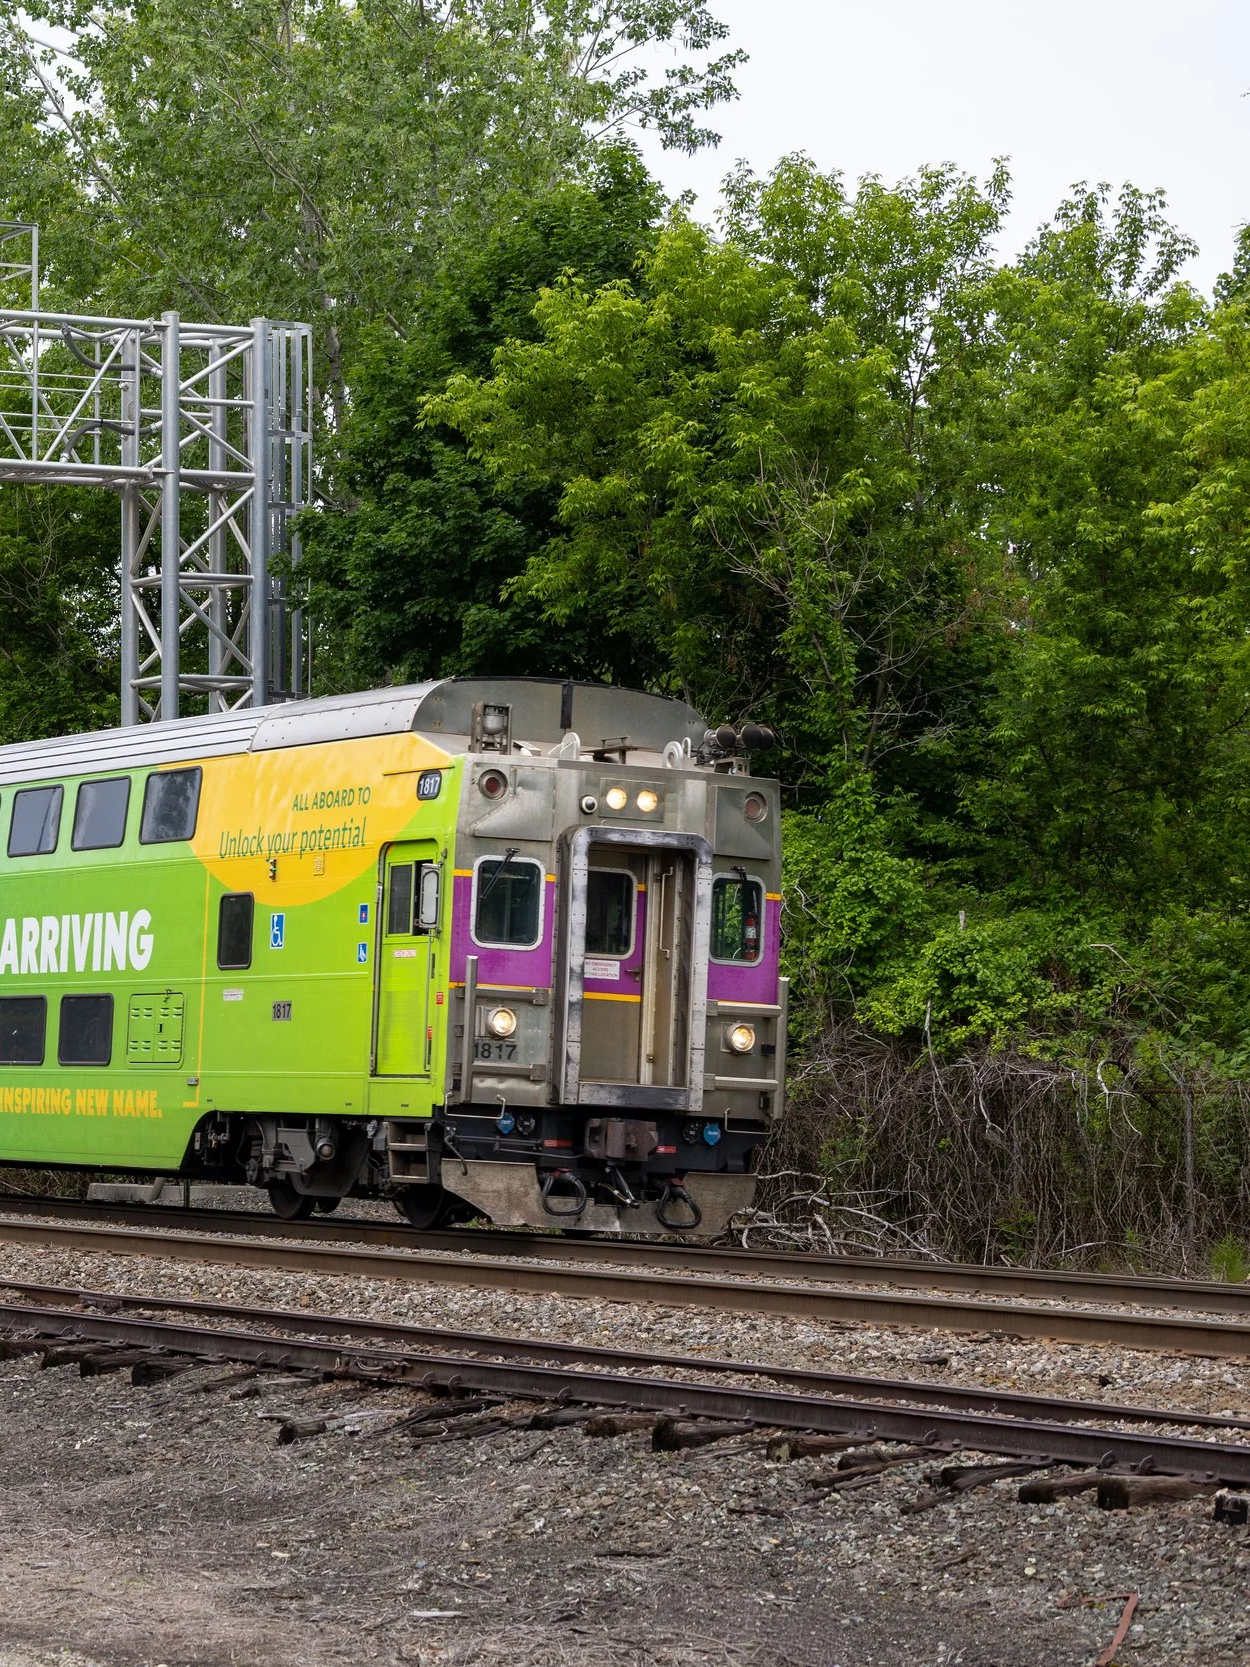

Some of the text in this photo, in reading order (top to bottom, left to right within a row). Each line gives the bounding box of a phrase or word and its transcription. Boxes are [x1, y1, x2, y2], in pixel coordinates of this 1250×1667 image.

[420, 776, 440, 795] 1817
[292, 786, 371, 812] ALL ABOARD TO
[219, 816, 367, 862] Unlock your potential
[272, 1003, 292, 1019] 1817
[473, 1042, 518, 1060] 1817
[0, 1086, 72, 1116] INSPIRING
[75, 1088, 110, 1117] NEW
[113, 1089, 163, 1118] NAME.
